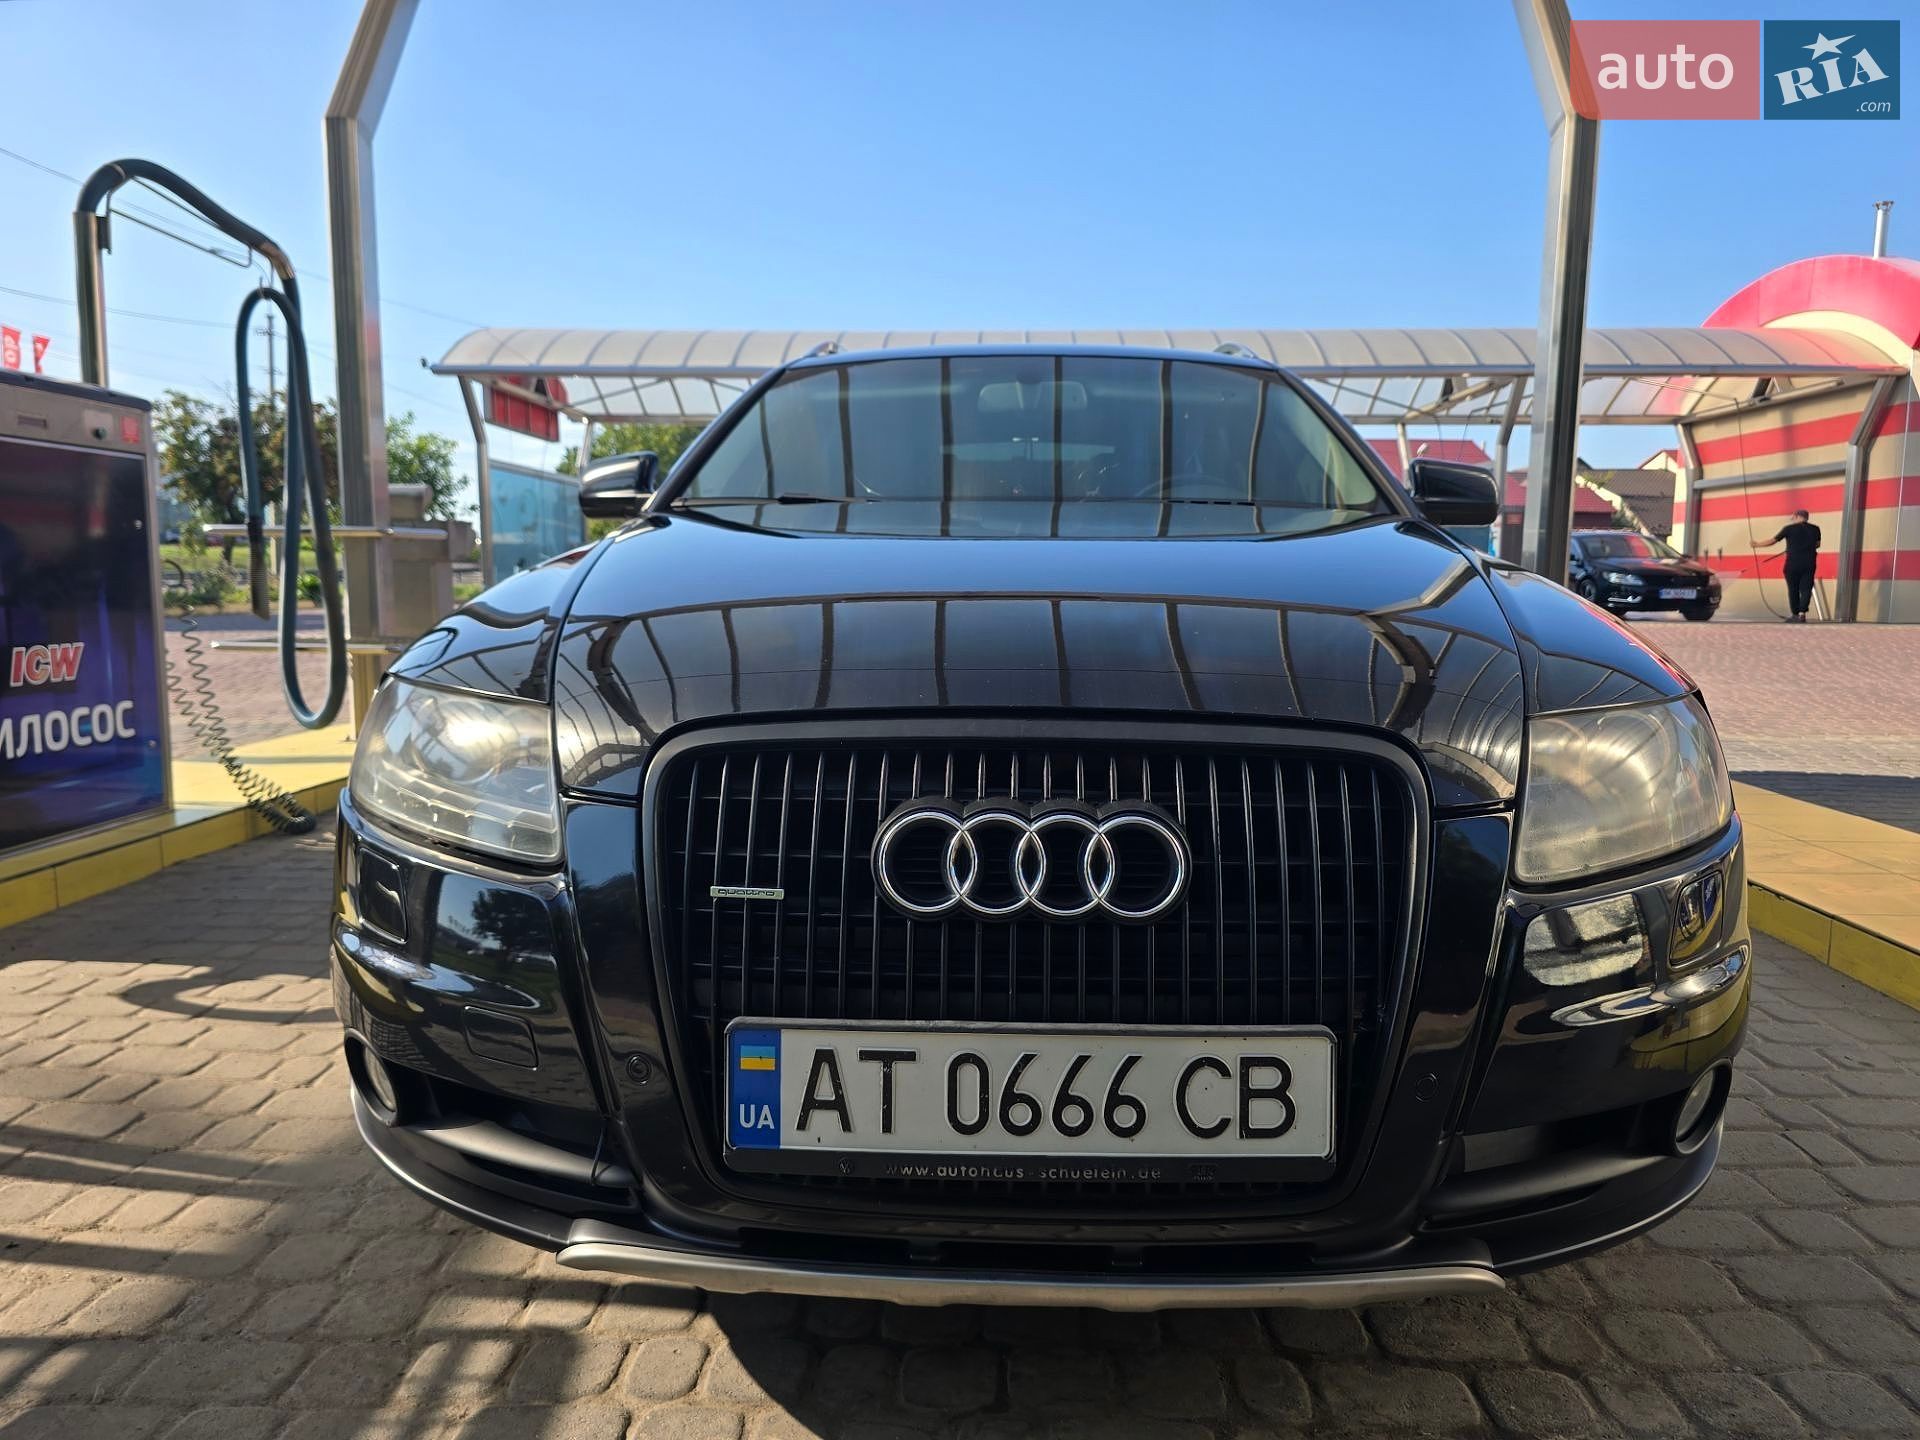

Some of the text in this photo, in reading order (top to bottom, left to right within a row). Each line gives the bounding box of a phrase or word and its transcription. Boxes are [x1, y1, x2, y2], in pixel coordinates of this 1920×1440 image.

[10, 642, 84, 687] ICW
[717, 888, 775, 897] quattro
[796, 1048, 1297, 1140] AT 0666 CB
[739, 1104, 775, 1129] UA
